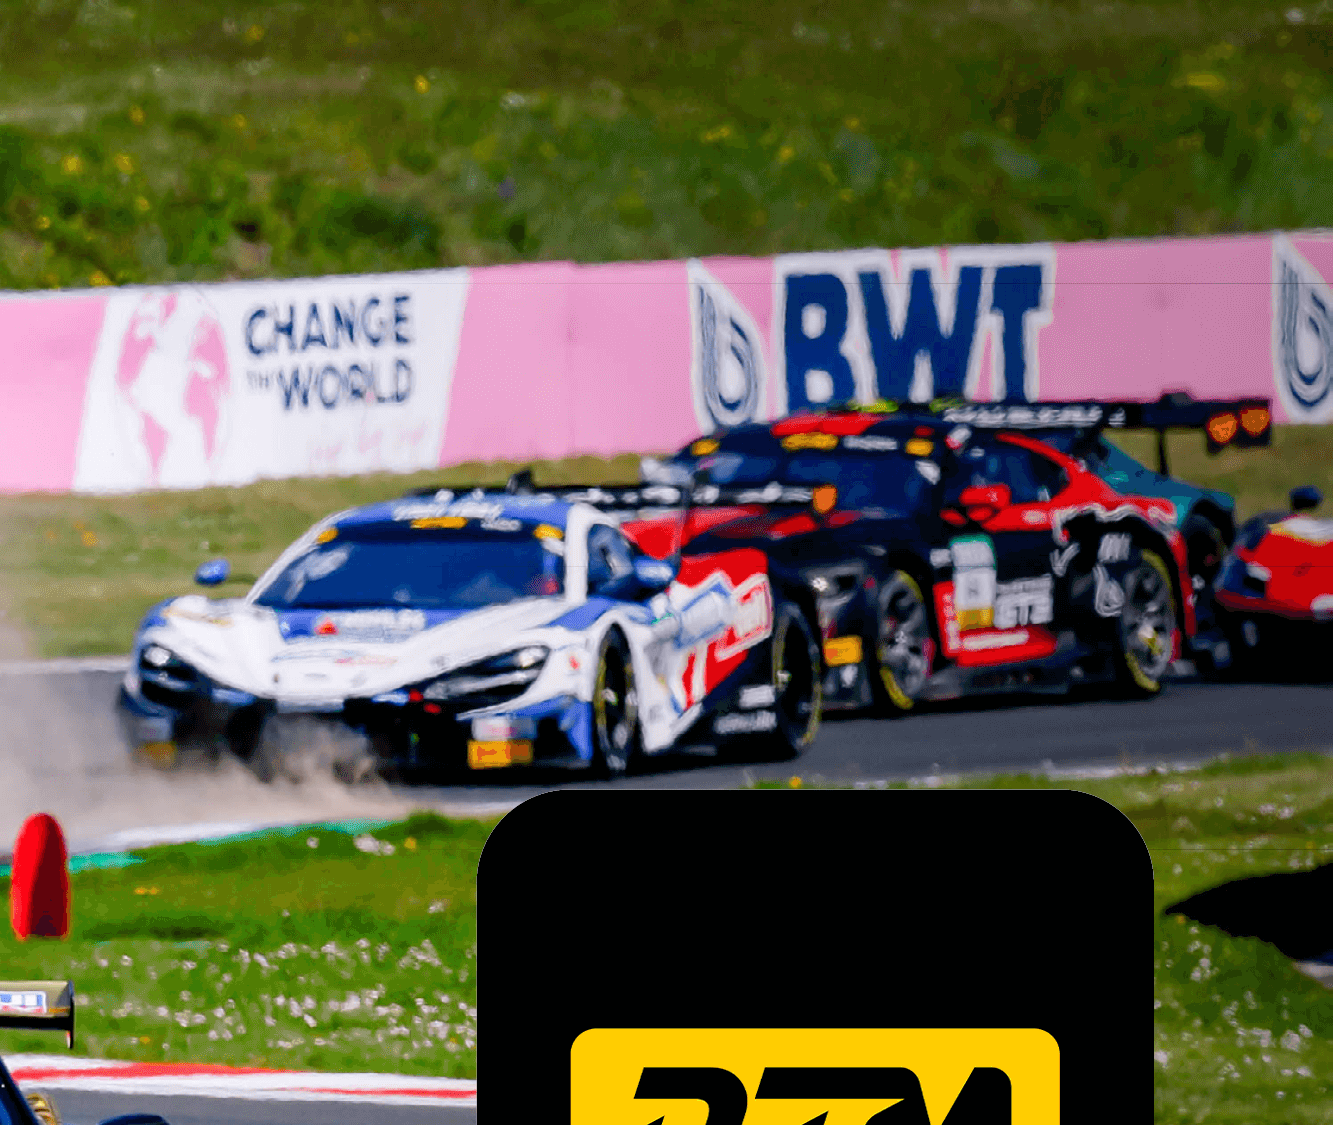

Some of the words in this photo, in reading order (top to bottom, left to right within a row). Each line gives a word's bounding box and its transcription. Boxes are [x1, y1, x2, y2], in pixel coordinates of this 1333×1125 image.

[245, 295, 411, 355] CHANGE
[783, 264, 1043, 404] BWT
[277, 359, 413, 411] WORLD
